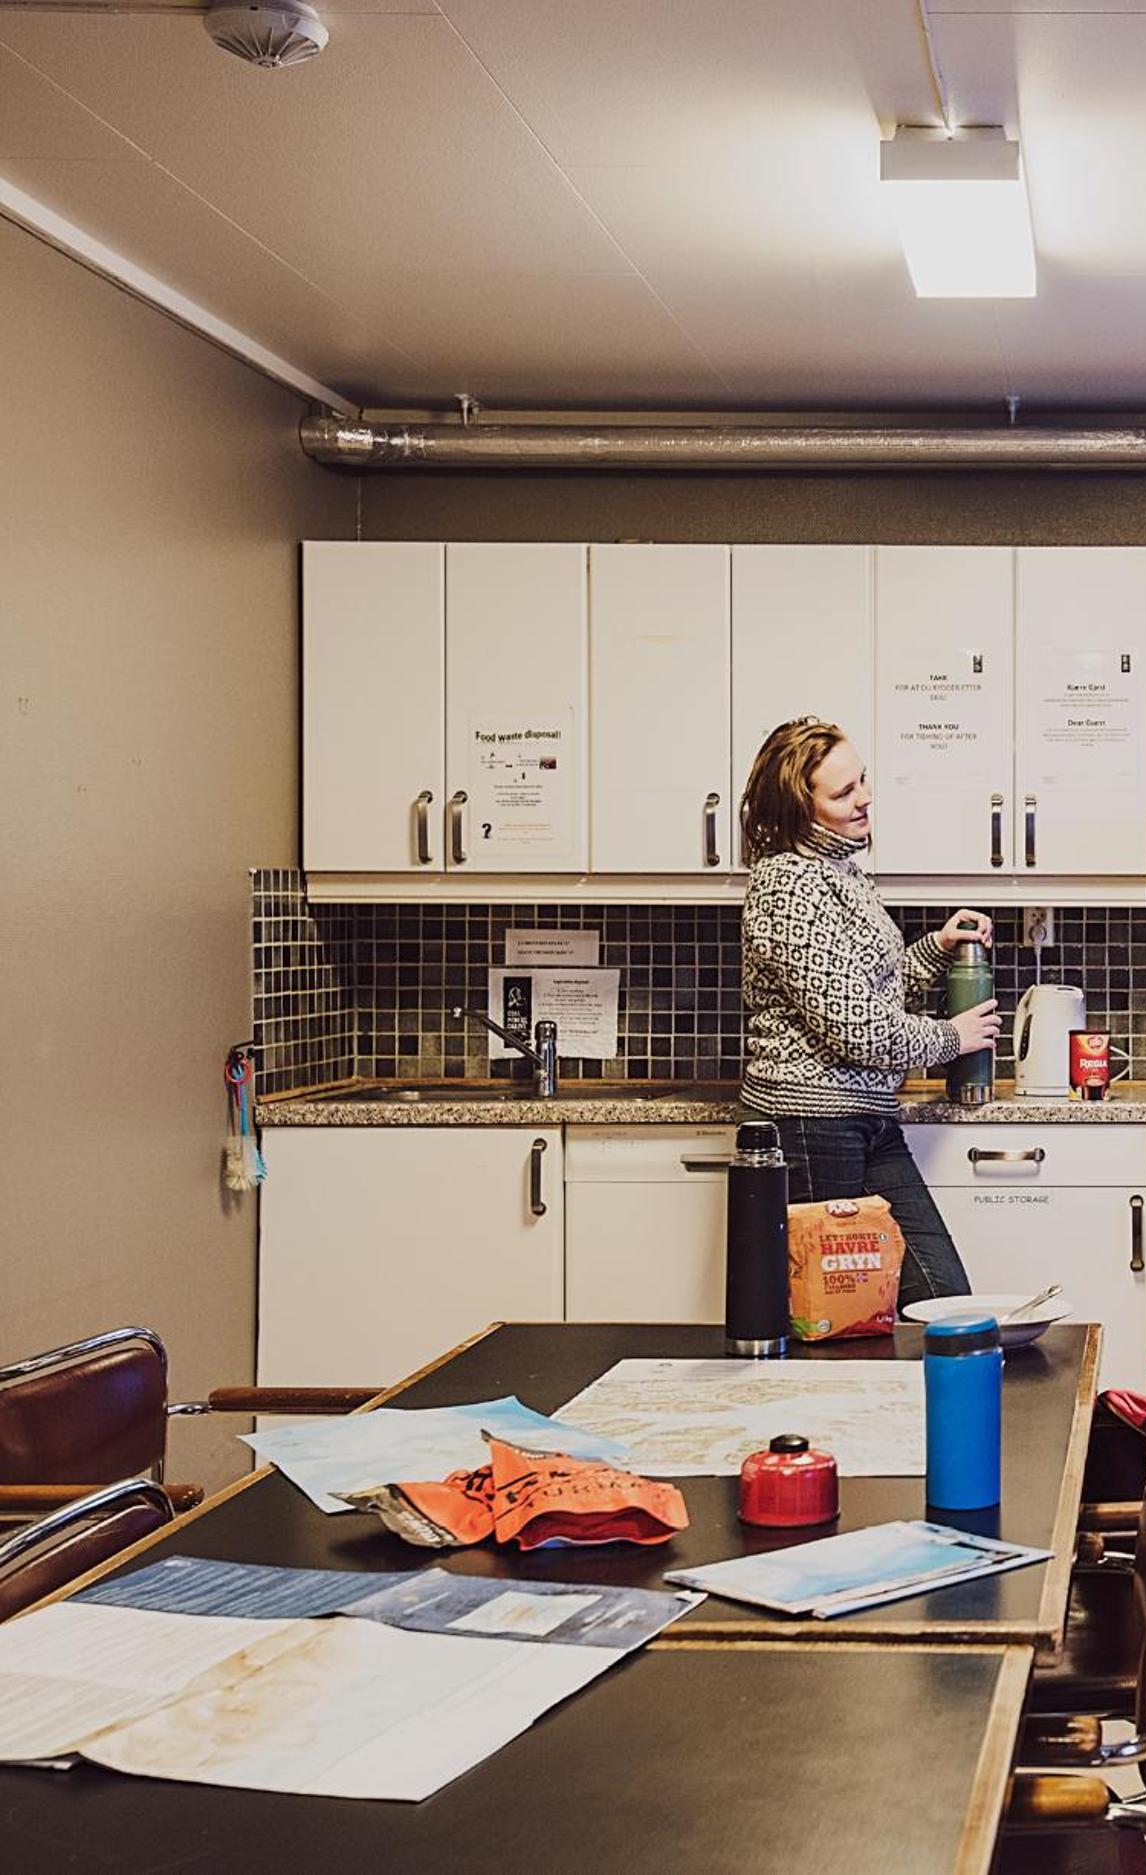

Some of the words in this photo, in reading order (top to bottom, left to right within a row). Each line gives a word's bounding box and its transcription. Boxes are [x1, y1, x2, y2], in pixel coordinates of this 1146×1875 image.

[475, 730, 496, 742] Food
[498, 732, 523, 743] waste
[524, 729, 561, 740] disposal!
[974, 1195, 1005, 1204] PUBLIC
[1008, 1195, 1049, 1204] STORAGE
[820, 1240, 880, 1255] HAVRE
[821, 1252, 881, 1272] GRYN
[823, 1273, 856, 1285] 100%
